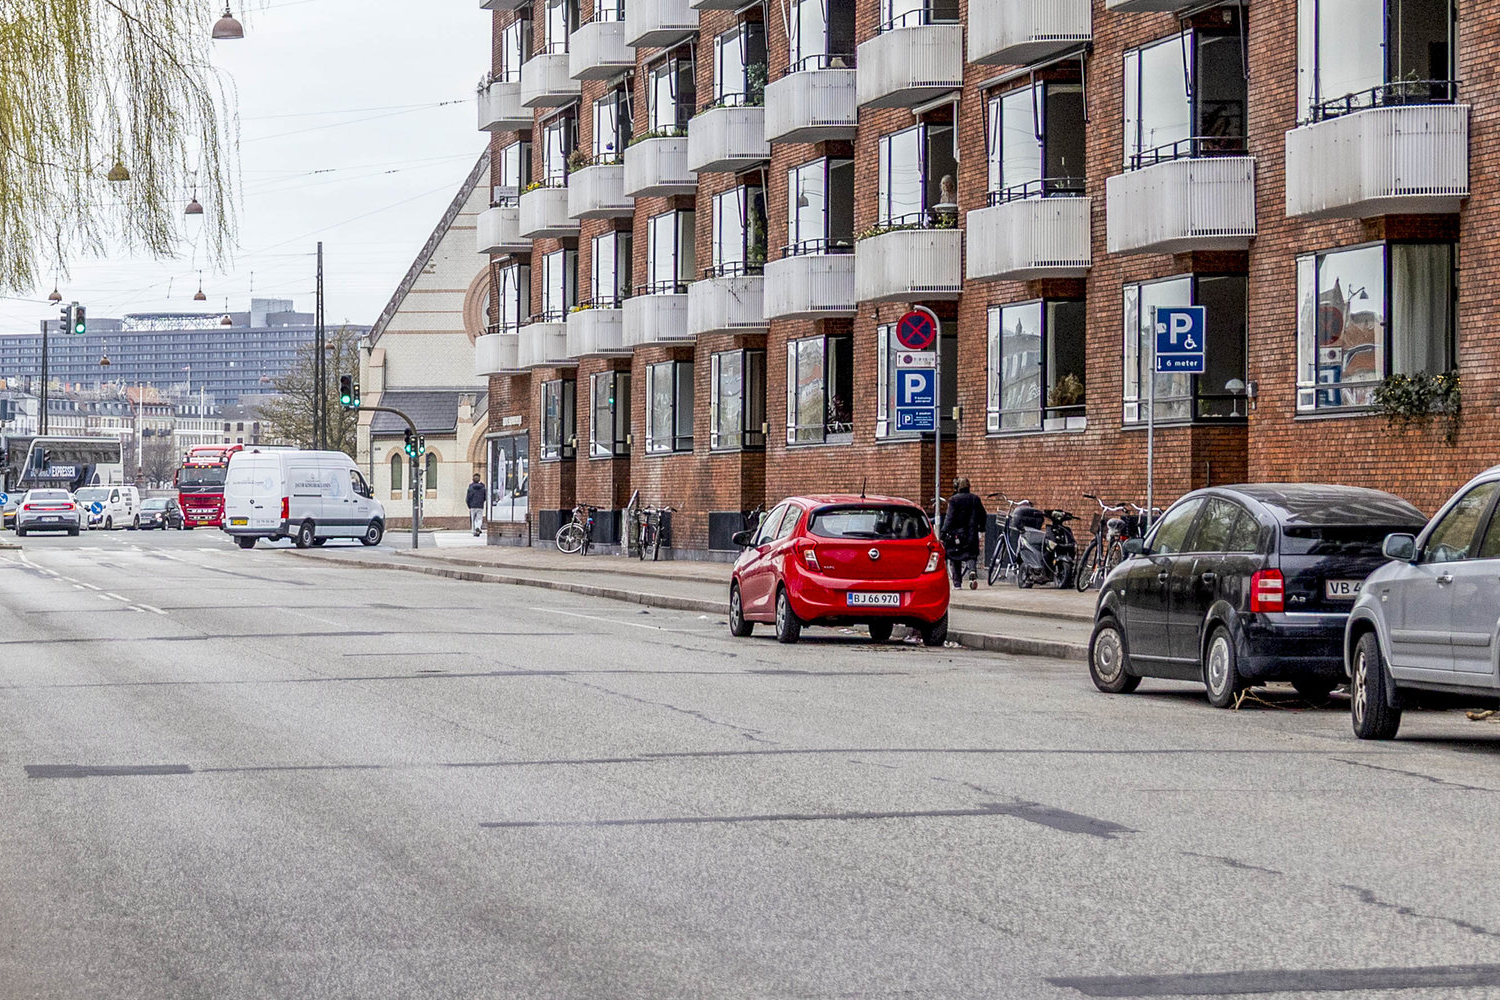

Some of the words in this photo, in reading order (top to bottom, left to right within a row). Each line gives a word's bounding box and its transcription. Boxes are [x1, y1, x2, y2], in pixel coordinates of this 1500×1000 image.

[1170, 313, 1192, 344] P
[905, 373, 927, 403] P
[905, 415, 911, 424] P
[1329, 582, 1350, 594] VB
[854, 595, 866, 603] BJ
[868, 595, 880, 603] 66
[881, 594, 898, 603] 970
